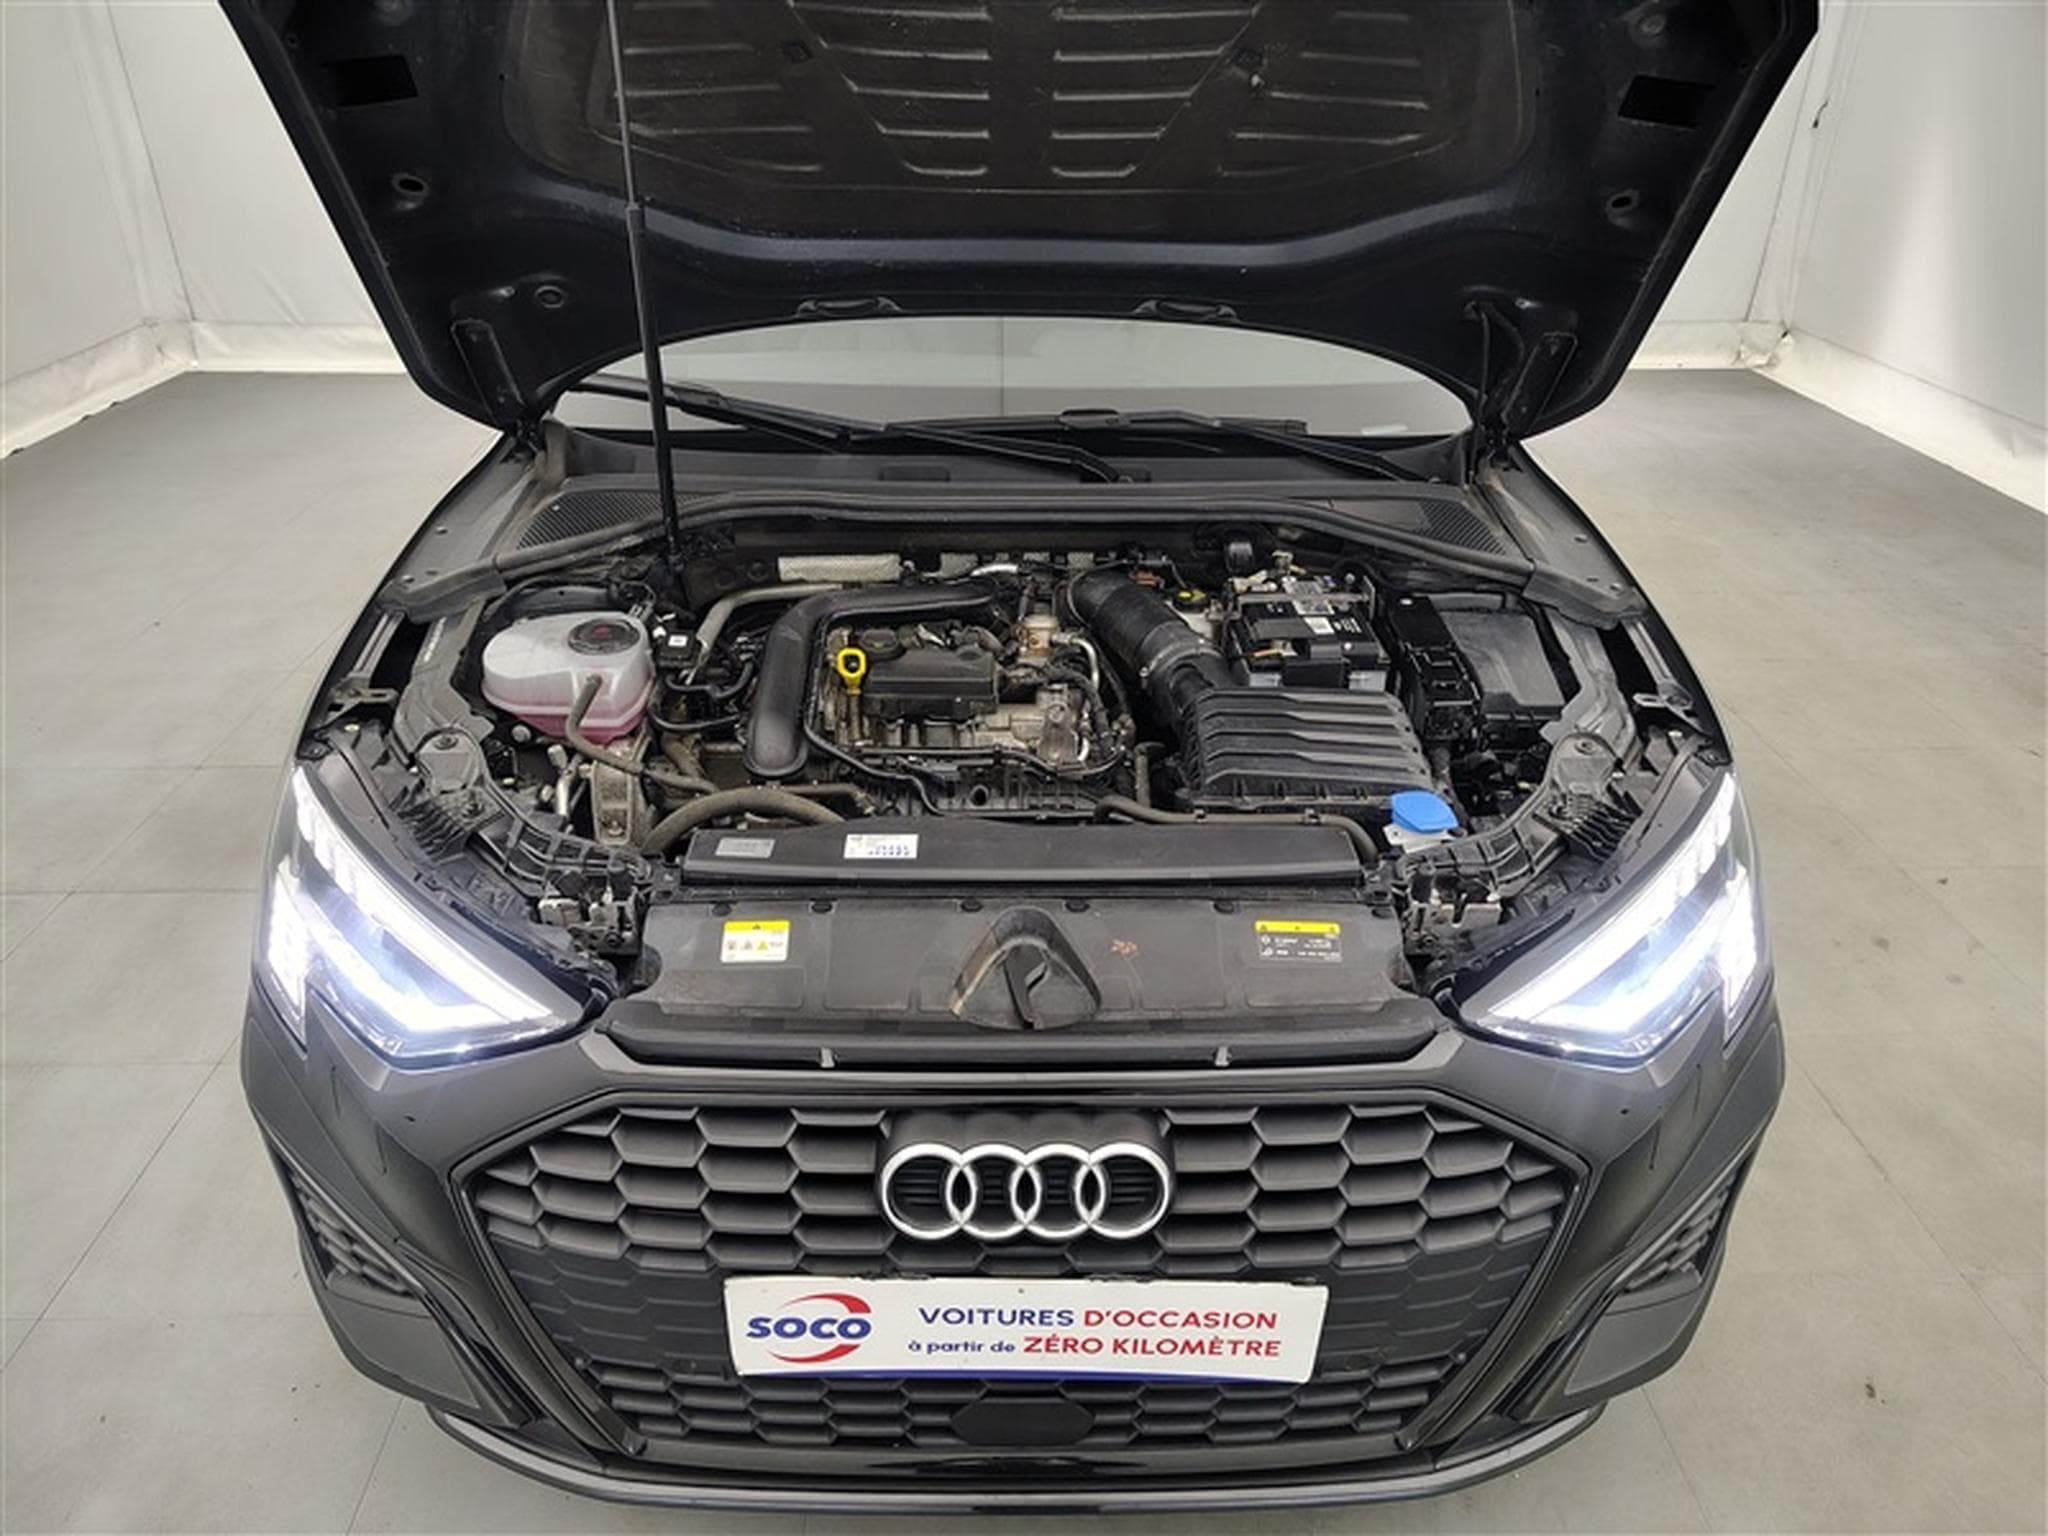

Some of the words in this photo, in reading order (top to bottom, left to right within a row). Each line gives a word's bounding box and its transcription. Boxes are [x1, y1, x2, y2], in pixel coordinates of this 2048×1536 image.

[746, 1317, 872, 1340] SOCO
[918, 1307, 1075, 1327] VOITURES
[1083, 1309, 1278, 1329] D'OCCASION
[907, 1339, 922, 1352] à
[926, 1339, 986, 1355] partir
[990, 1339, 1016, 1353] de
[1023, 1333, 1104, 1354] ZÉRO
[1112, 1336, 1282, 1357] KILOMÈTRE
